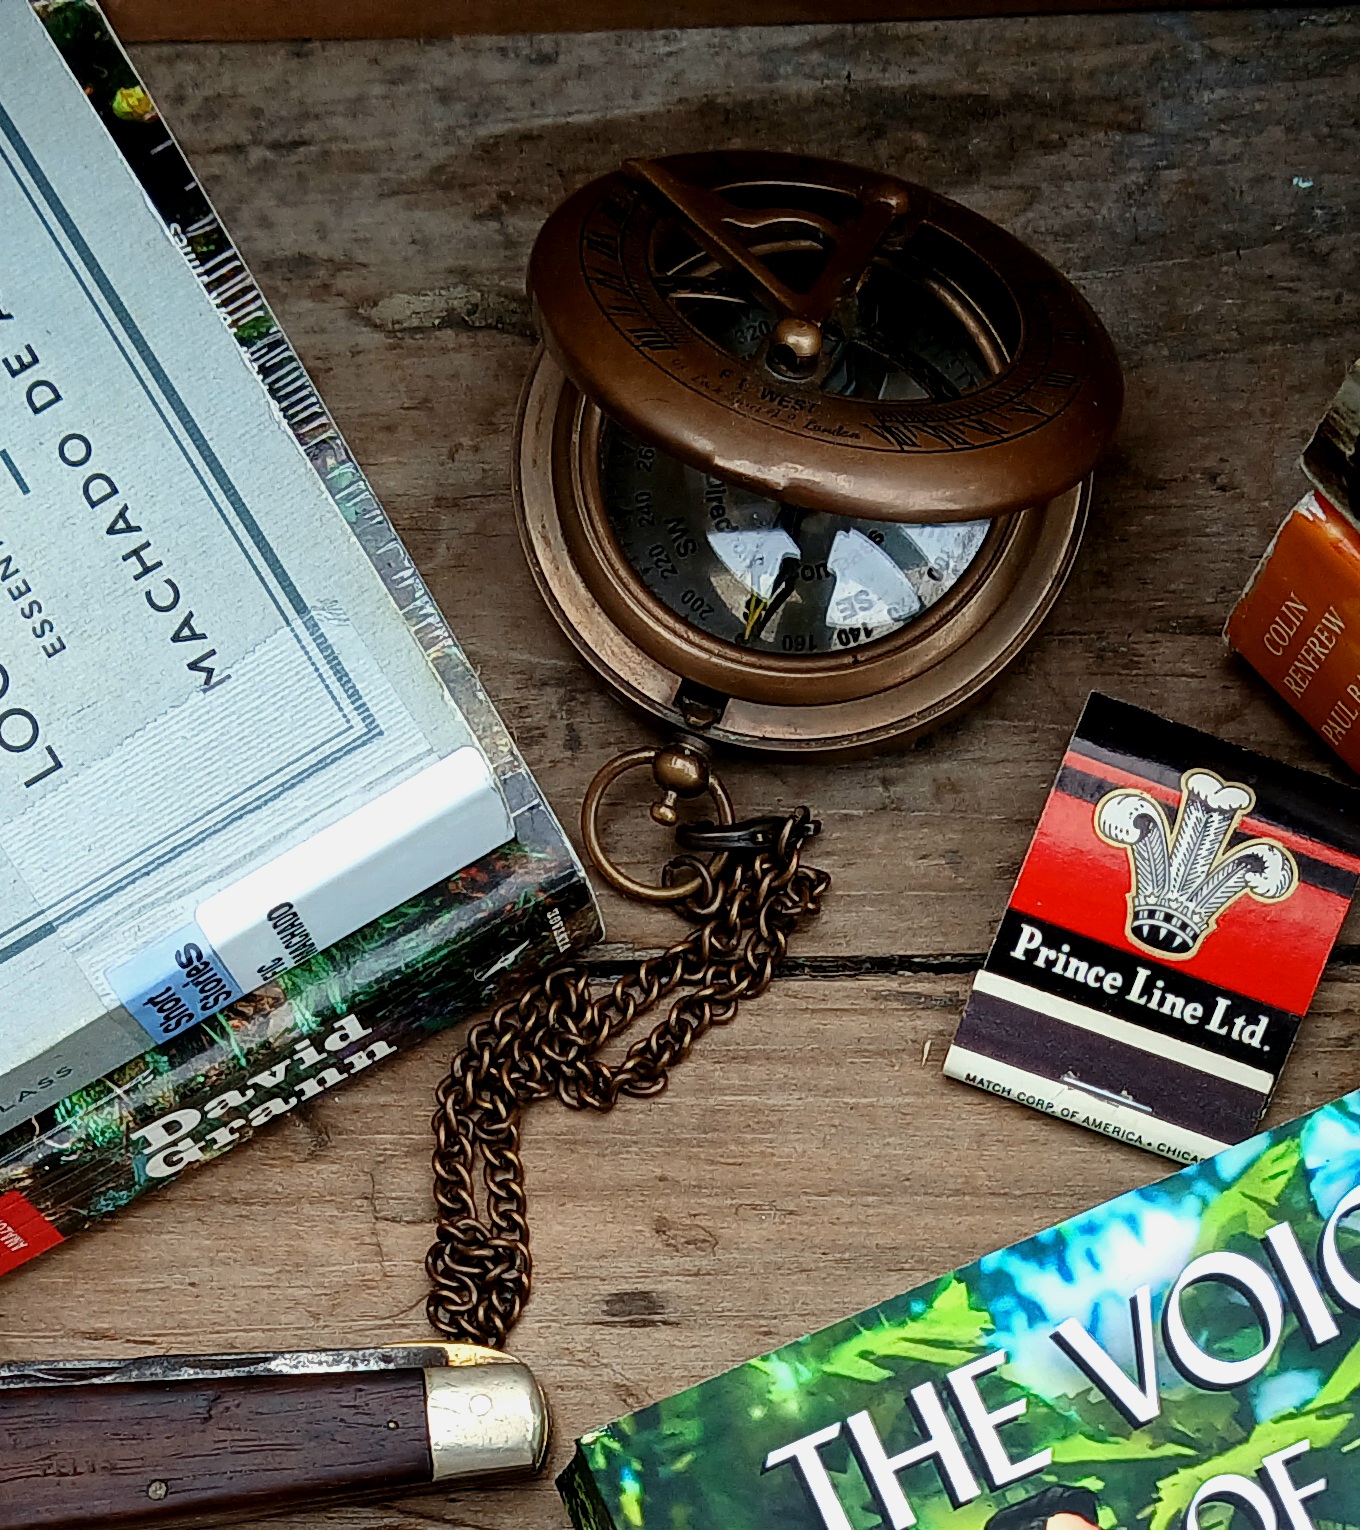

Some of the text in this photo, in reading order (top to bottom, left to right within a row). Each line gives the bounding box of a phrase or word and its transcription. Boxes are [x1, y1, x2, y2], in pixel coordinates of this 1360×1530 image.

[3, 343, 64, 416] DE
[639, 445, 656, 473] 26
[57, 432, 233, 694] MACHADO
[665, 515, 698, 558] SW
[680, 587, 715, 620] 200
[835, 589, 874, 620] SE
[1262, 591, 1309, 659] COLIN
[782, 634, 818, 652] 160
[1282, 606, 1346, 700] RENFREW
[266, 901, 319, 964] MACHADO
[142, 986, 195, 1034] Short
[174, 942, 232, 1012] Stories
[1010, 923, 1271, 1052] Prince Line Ltd.
[132, 1012, 374, 1153] David
[137, 1034, 399, 1180] Grann
[965, 1072, 1013, 1099] MATCH
[1060, 1106, 1080, 1122] OF
[1081, 1114, 1146, 1146] AMERICA
